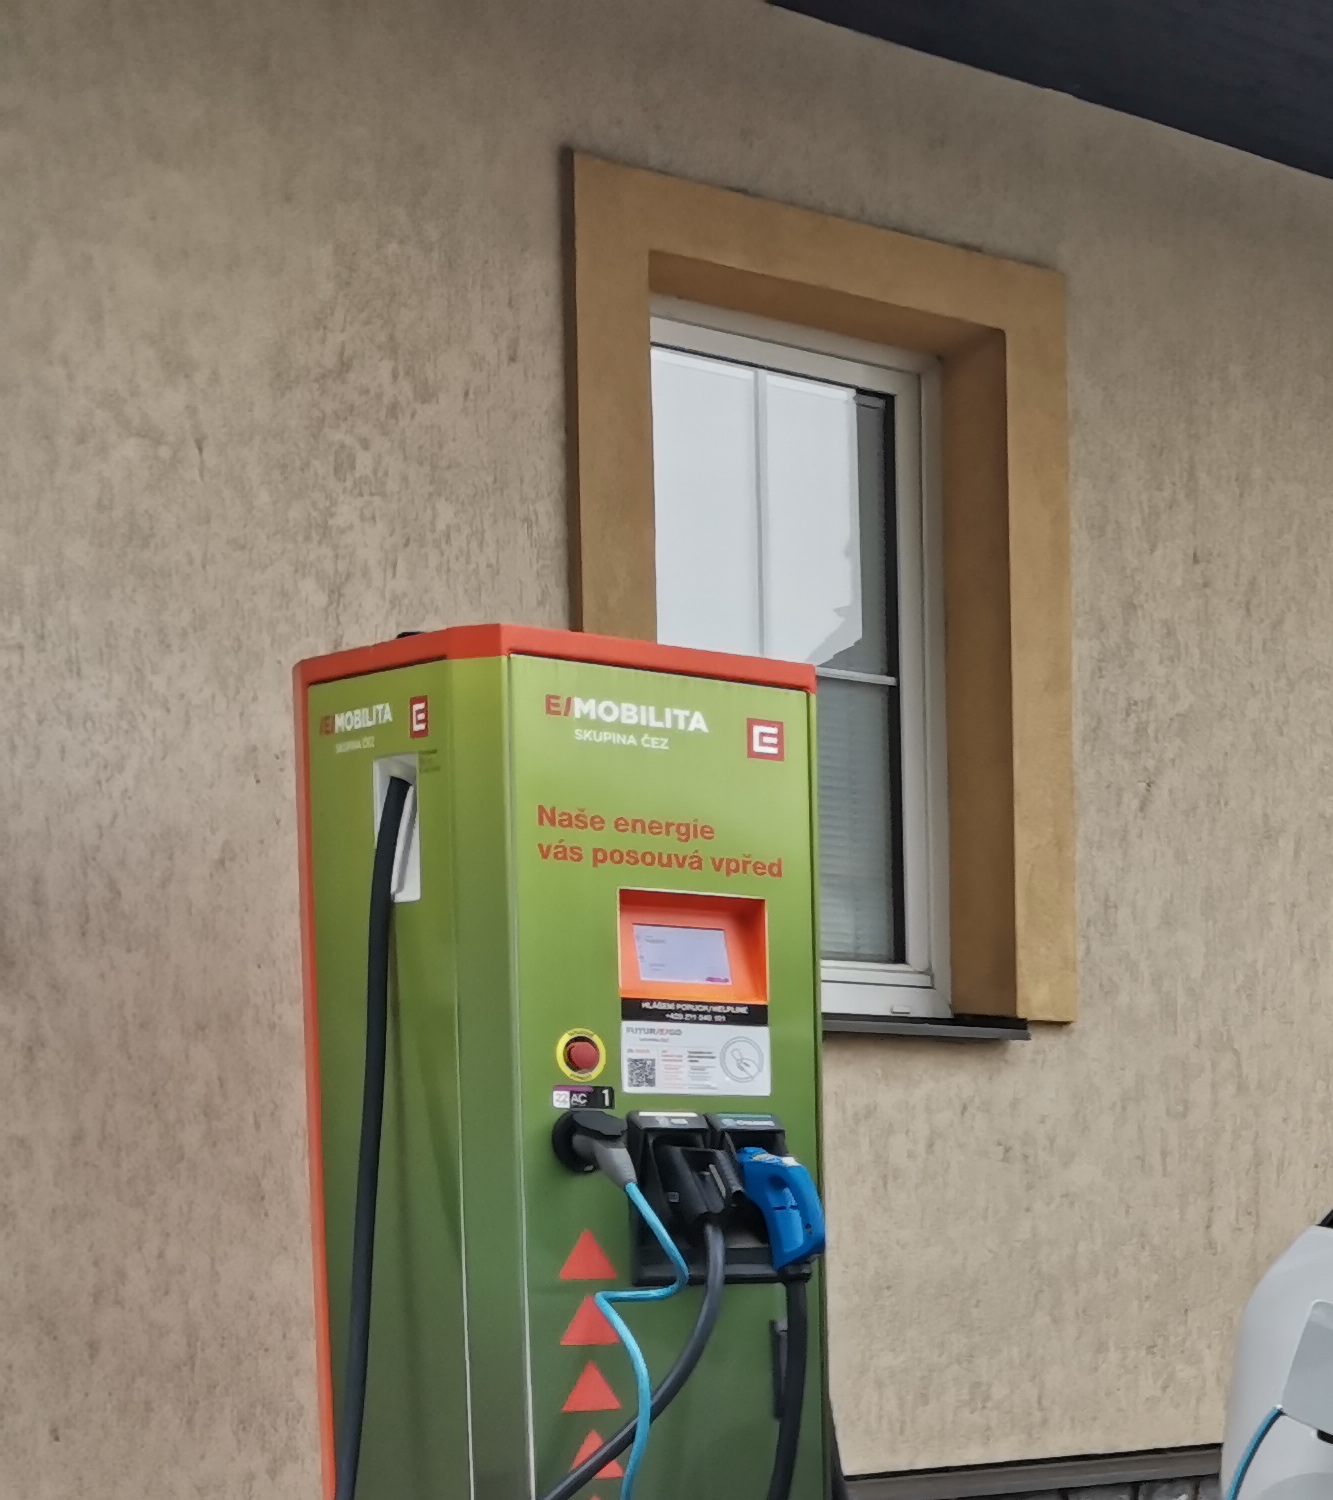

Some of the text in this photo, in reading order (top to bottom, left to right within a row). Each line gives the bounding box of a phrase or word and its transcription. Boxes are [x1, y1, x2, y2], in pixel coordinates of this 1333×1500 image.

[573, 728, 669, 750] SKUPINA ČEZ
[537, 804, 715, 843] Naše energie
[537, 839, 783, 878] vás posouvá vpřed
[571, 1093, 588, 1105] AC
[602, 1088, 610, 1107] 1
